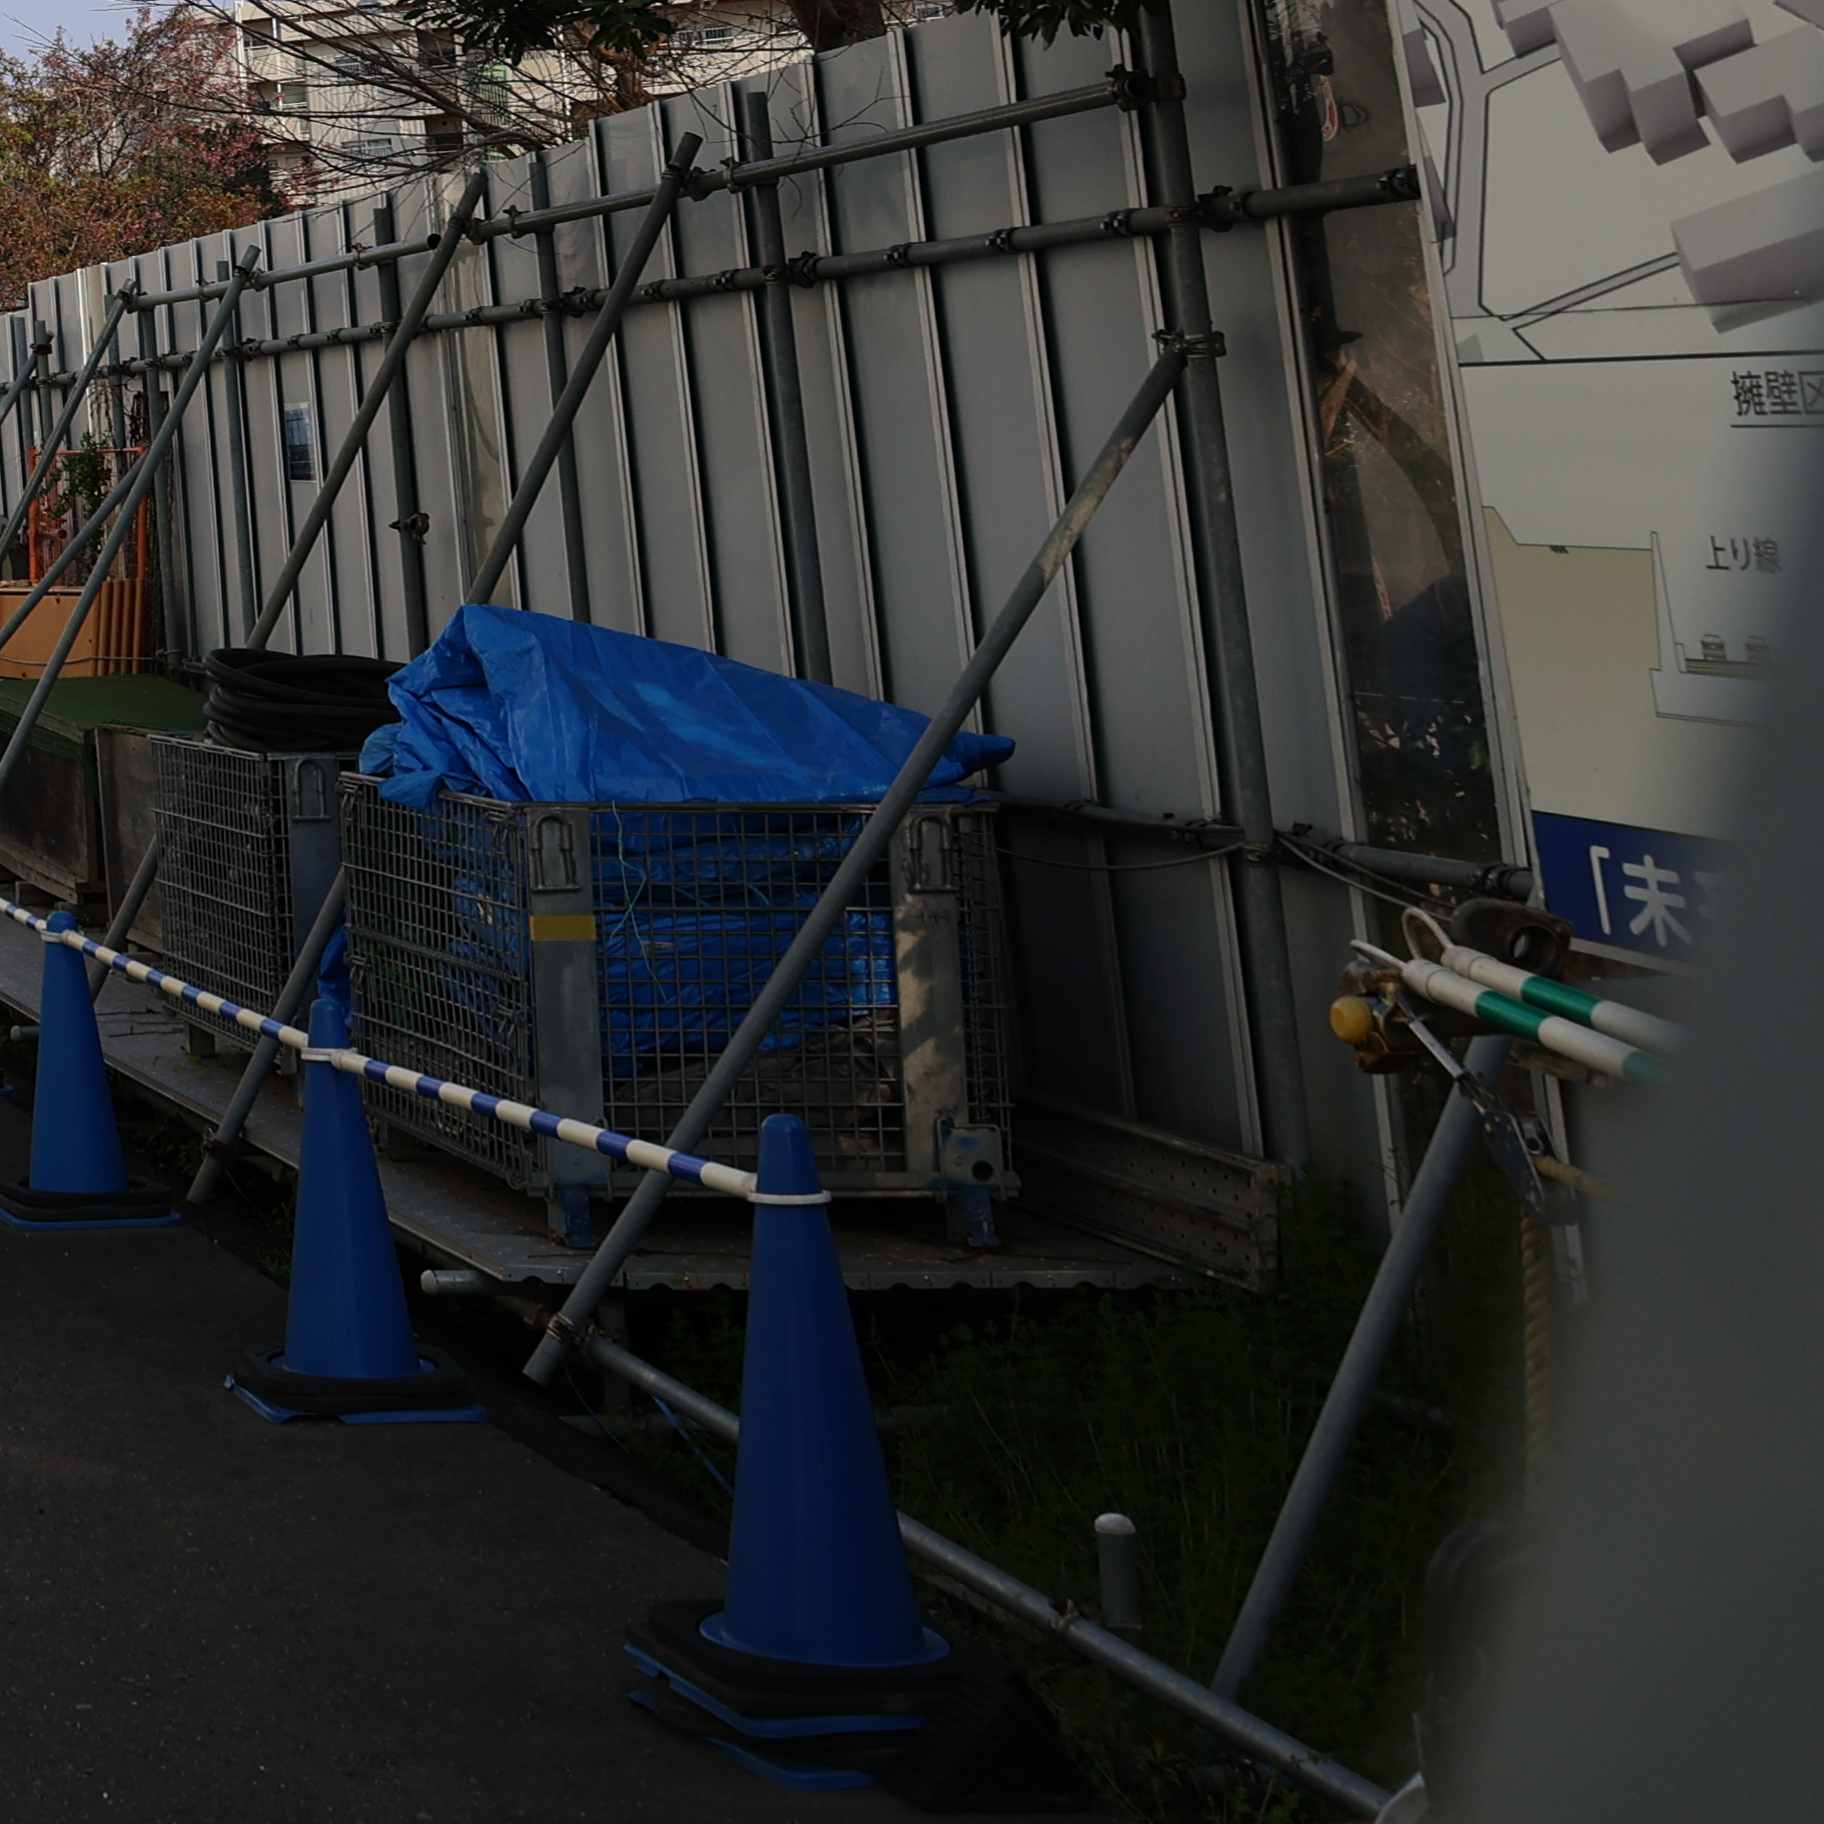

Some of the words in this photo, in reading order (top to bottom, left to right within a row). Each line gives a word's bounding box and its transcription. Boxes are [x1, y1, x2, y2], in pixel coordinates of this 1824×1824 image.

[1705, 535, 1782, 574] 上り線
[1589, 845, 1727, 948] 「未
